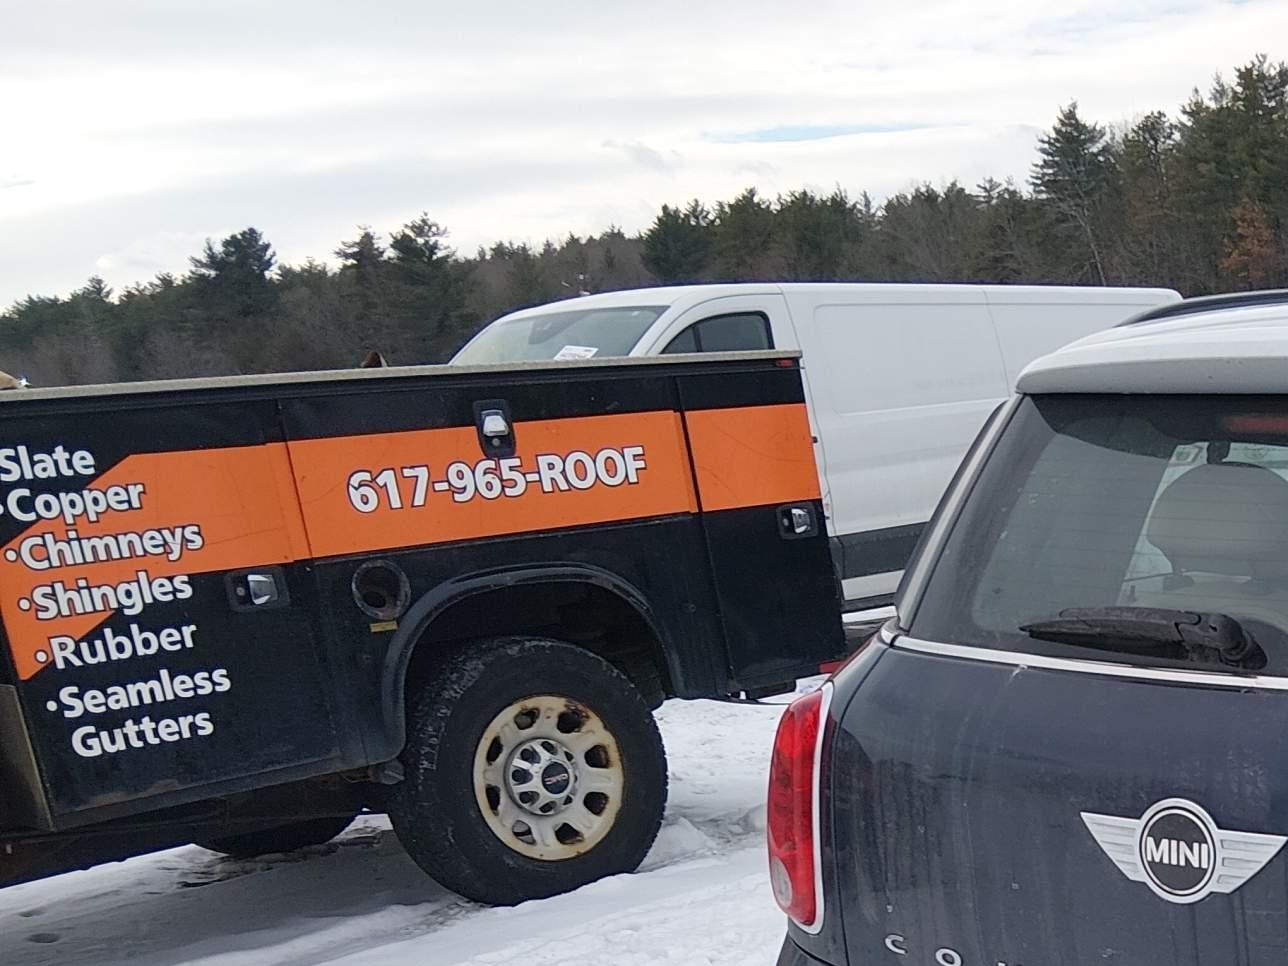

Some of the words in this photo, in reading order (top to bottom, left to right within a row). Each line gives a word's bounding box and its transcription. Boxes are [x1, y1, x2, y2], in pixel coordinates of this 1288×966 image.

[0, 445, 95, 482] Slate
[348, 445, 647, 513] 617-965-ROOF
[6, 483, 145, 525] Copper
[19, 524, 204, 570] Chimneys
[31, 570, 193, 620] Shingles
[50, 623, 197, 670] Rubber
[59, 668, 231, 718] Seamless
[71, 712, 214, 758] Gutters
[1146, 836, 1209, 869] MINI
